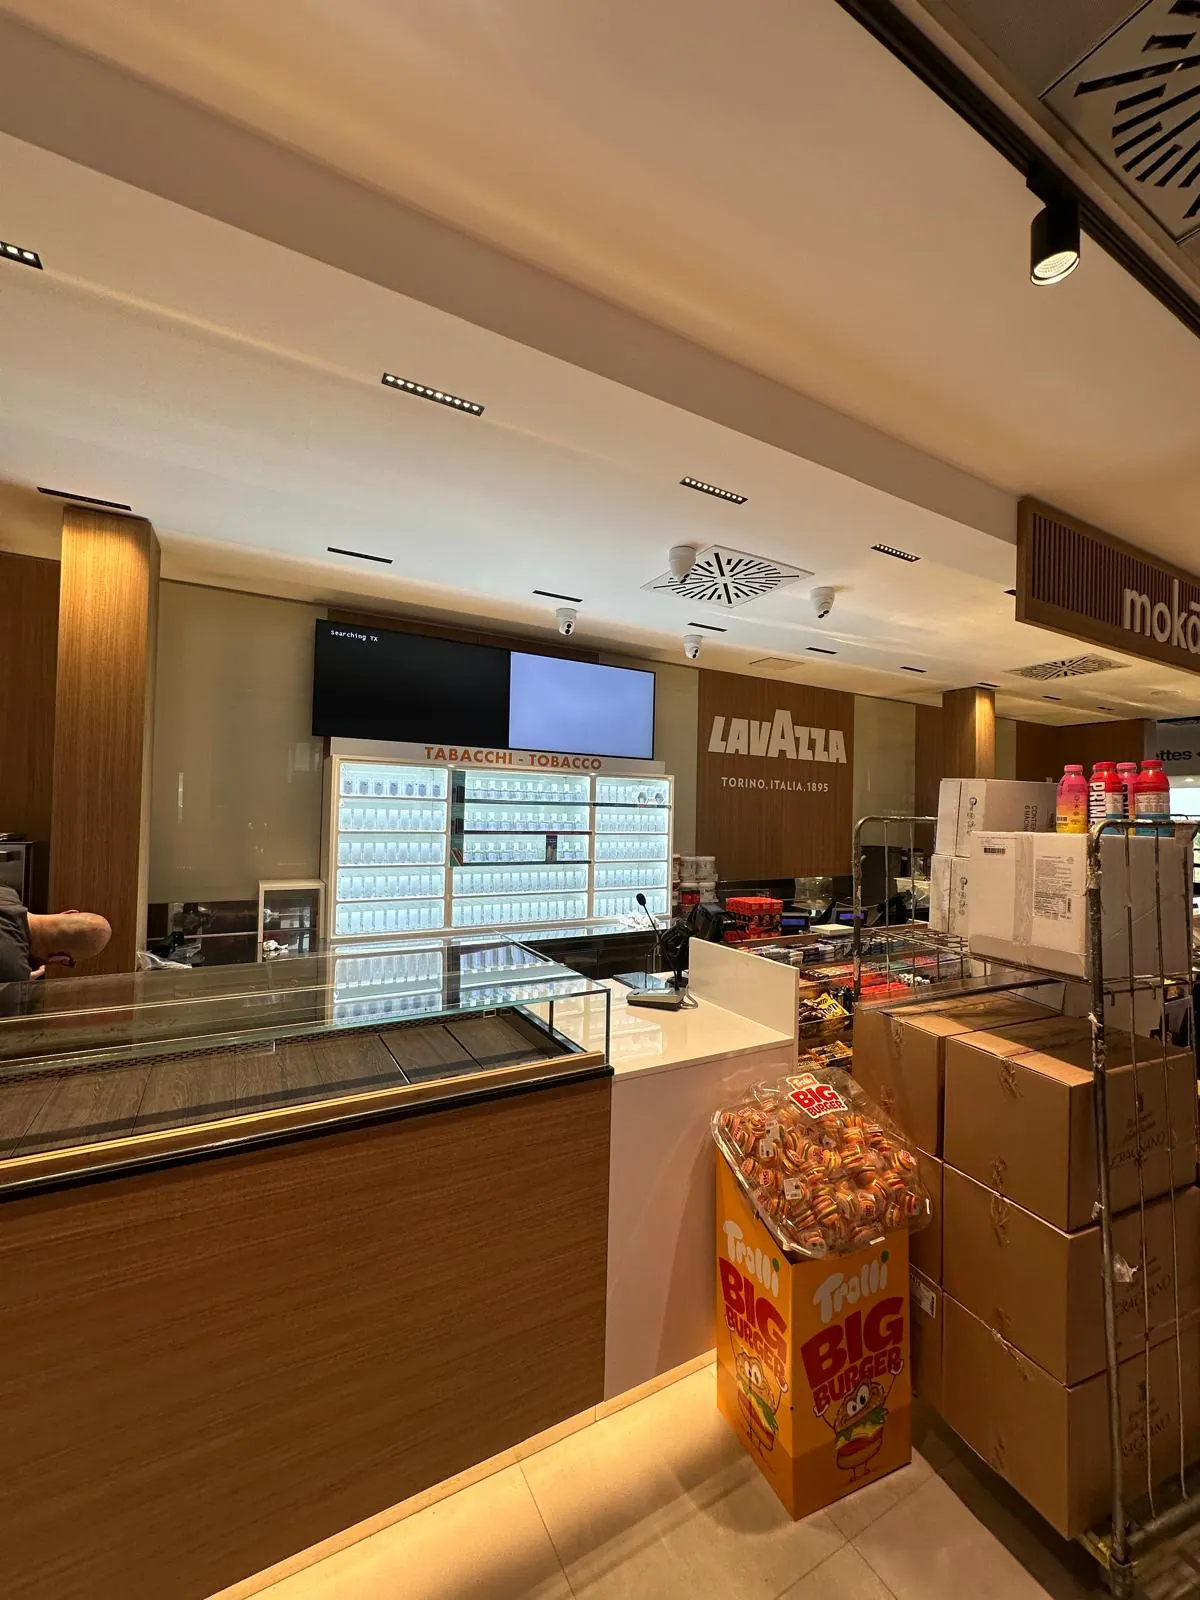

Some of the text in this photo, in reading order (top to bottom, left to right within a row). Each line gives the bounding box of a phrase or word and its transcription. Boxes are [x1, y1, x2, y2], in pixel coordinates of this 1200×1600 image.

[424, 746, 513, 765] TABACCHI
[528, 753, 602, 770] TOBACCO
[707, 708, 847, 764] LAVAZZA
[807, 782, 829, 792] 1895
[791, 1085, 840, 1109] BIG
[806, 1100, 846, 1117] BURGER
[723, 1220, 779, 1298] Trolli
[813, 1250, 888, 1324] Trolli
[718, 1256, 788, 1365] BIG
[801, 1296, 904, 1389] BIG
[725, 1303, 787, 1387] BURGER
[812, 1346, 902, 1413] BURGER
